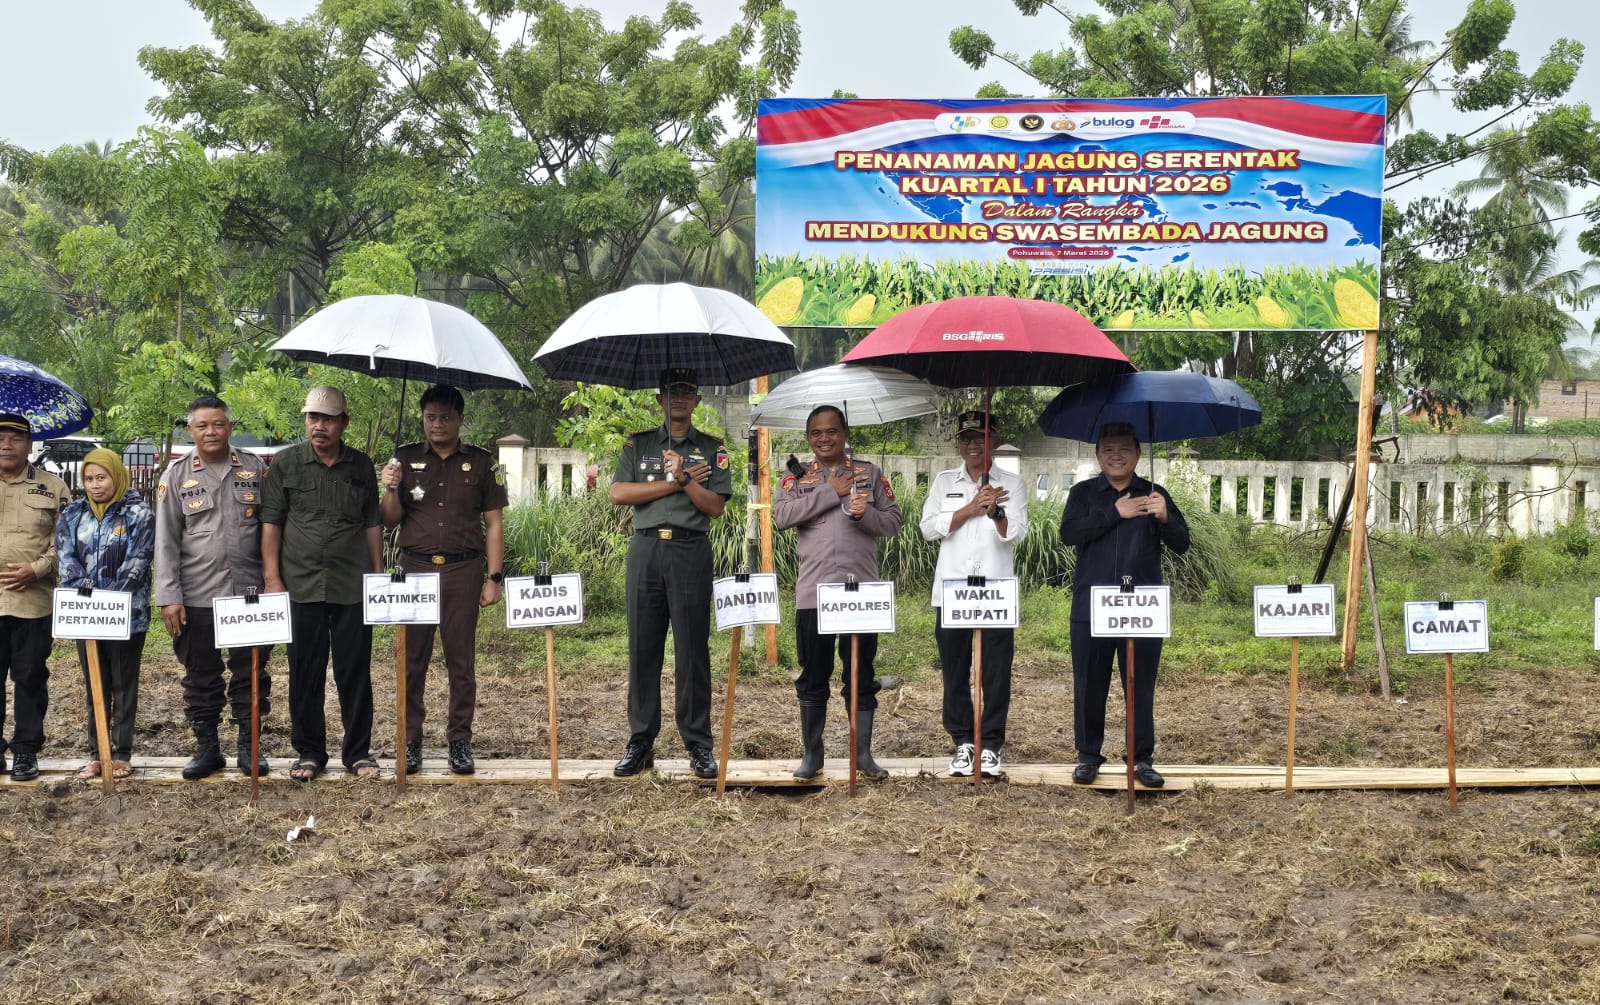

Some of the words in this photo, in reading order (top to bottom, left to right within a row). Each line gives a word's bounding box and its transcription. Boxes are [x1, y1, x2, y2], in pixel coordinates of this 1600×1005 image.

[1093, 117, 1134, 128] bulog
[837, 153, 1016, 169] PENANAMAN
[1022, 152, 1138, 169] JAGUNG
[1145, 151, 1298, 168] SERENTAK
[902, 177, 1029, 193] KUARTAL
[1036, 177, 1044, 193] I
[1053, 176, 1147, 193] TAHUN
[1155, 176, 1228, 193] 2026
[983, 202, 1053, 217] Dalam
[1061, 201, 1141, 222] Rangka
[808, 223, 988, 241] MENDUKUNG
[996, 224, 1200, 241] SWASEMBADA
[1207, 224, 1324, 240] JAGUNG
[234, 481, 260, 489] POLRI
[181, 488, 207, 499] PUJA
[368, 593, 436, 604] KATIMKER
[520, 586, 568, 600] KADIS
[954, 589, 1005, 600] WAKIL
[60, 601, 125, 611] PENYULUH
[716, 591, 776, 610] DANDIM
[821, 601, 890, 612] KAPOLRES
[1101, 595, 1160, 607] KETUA
[512, 605, 577, 620] PANGAN
[951, 609, 1008, 620] BUPATI
[1259, 603, 1330, 617] KAJARI
[58, 615, 126, 626] PERTANIAN
[220, 611, 285, 625] KAPOLSEK
[1108, 617, 1154, 629] DPRD
[1412, 619, 1482, 634] CAMAT
